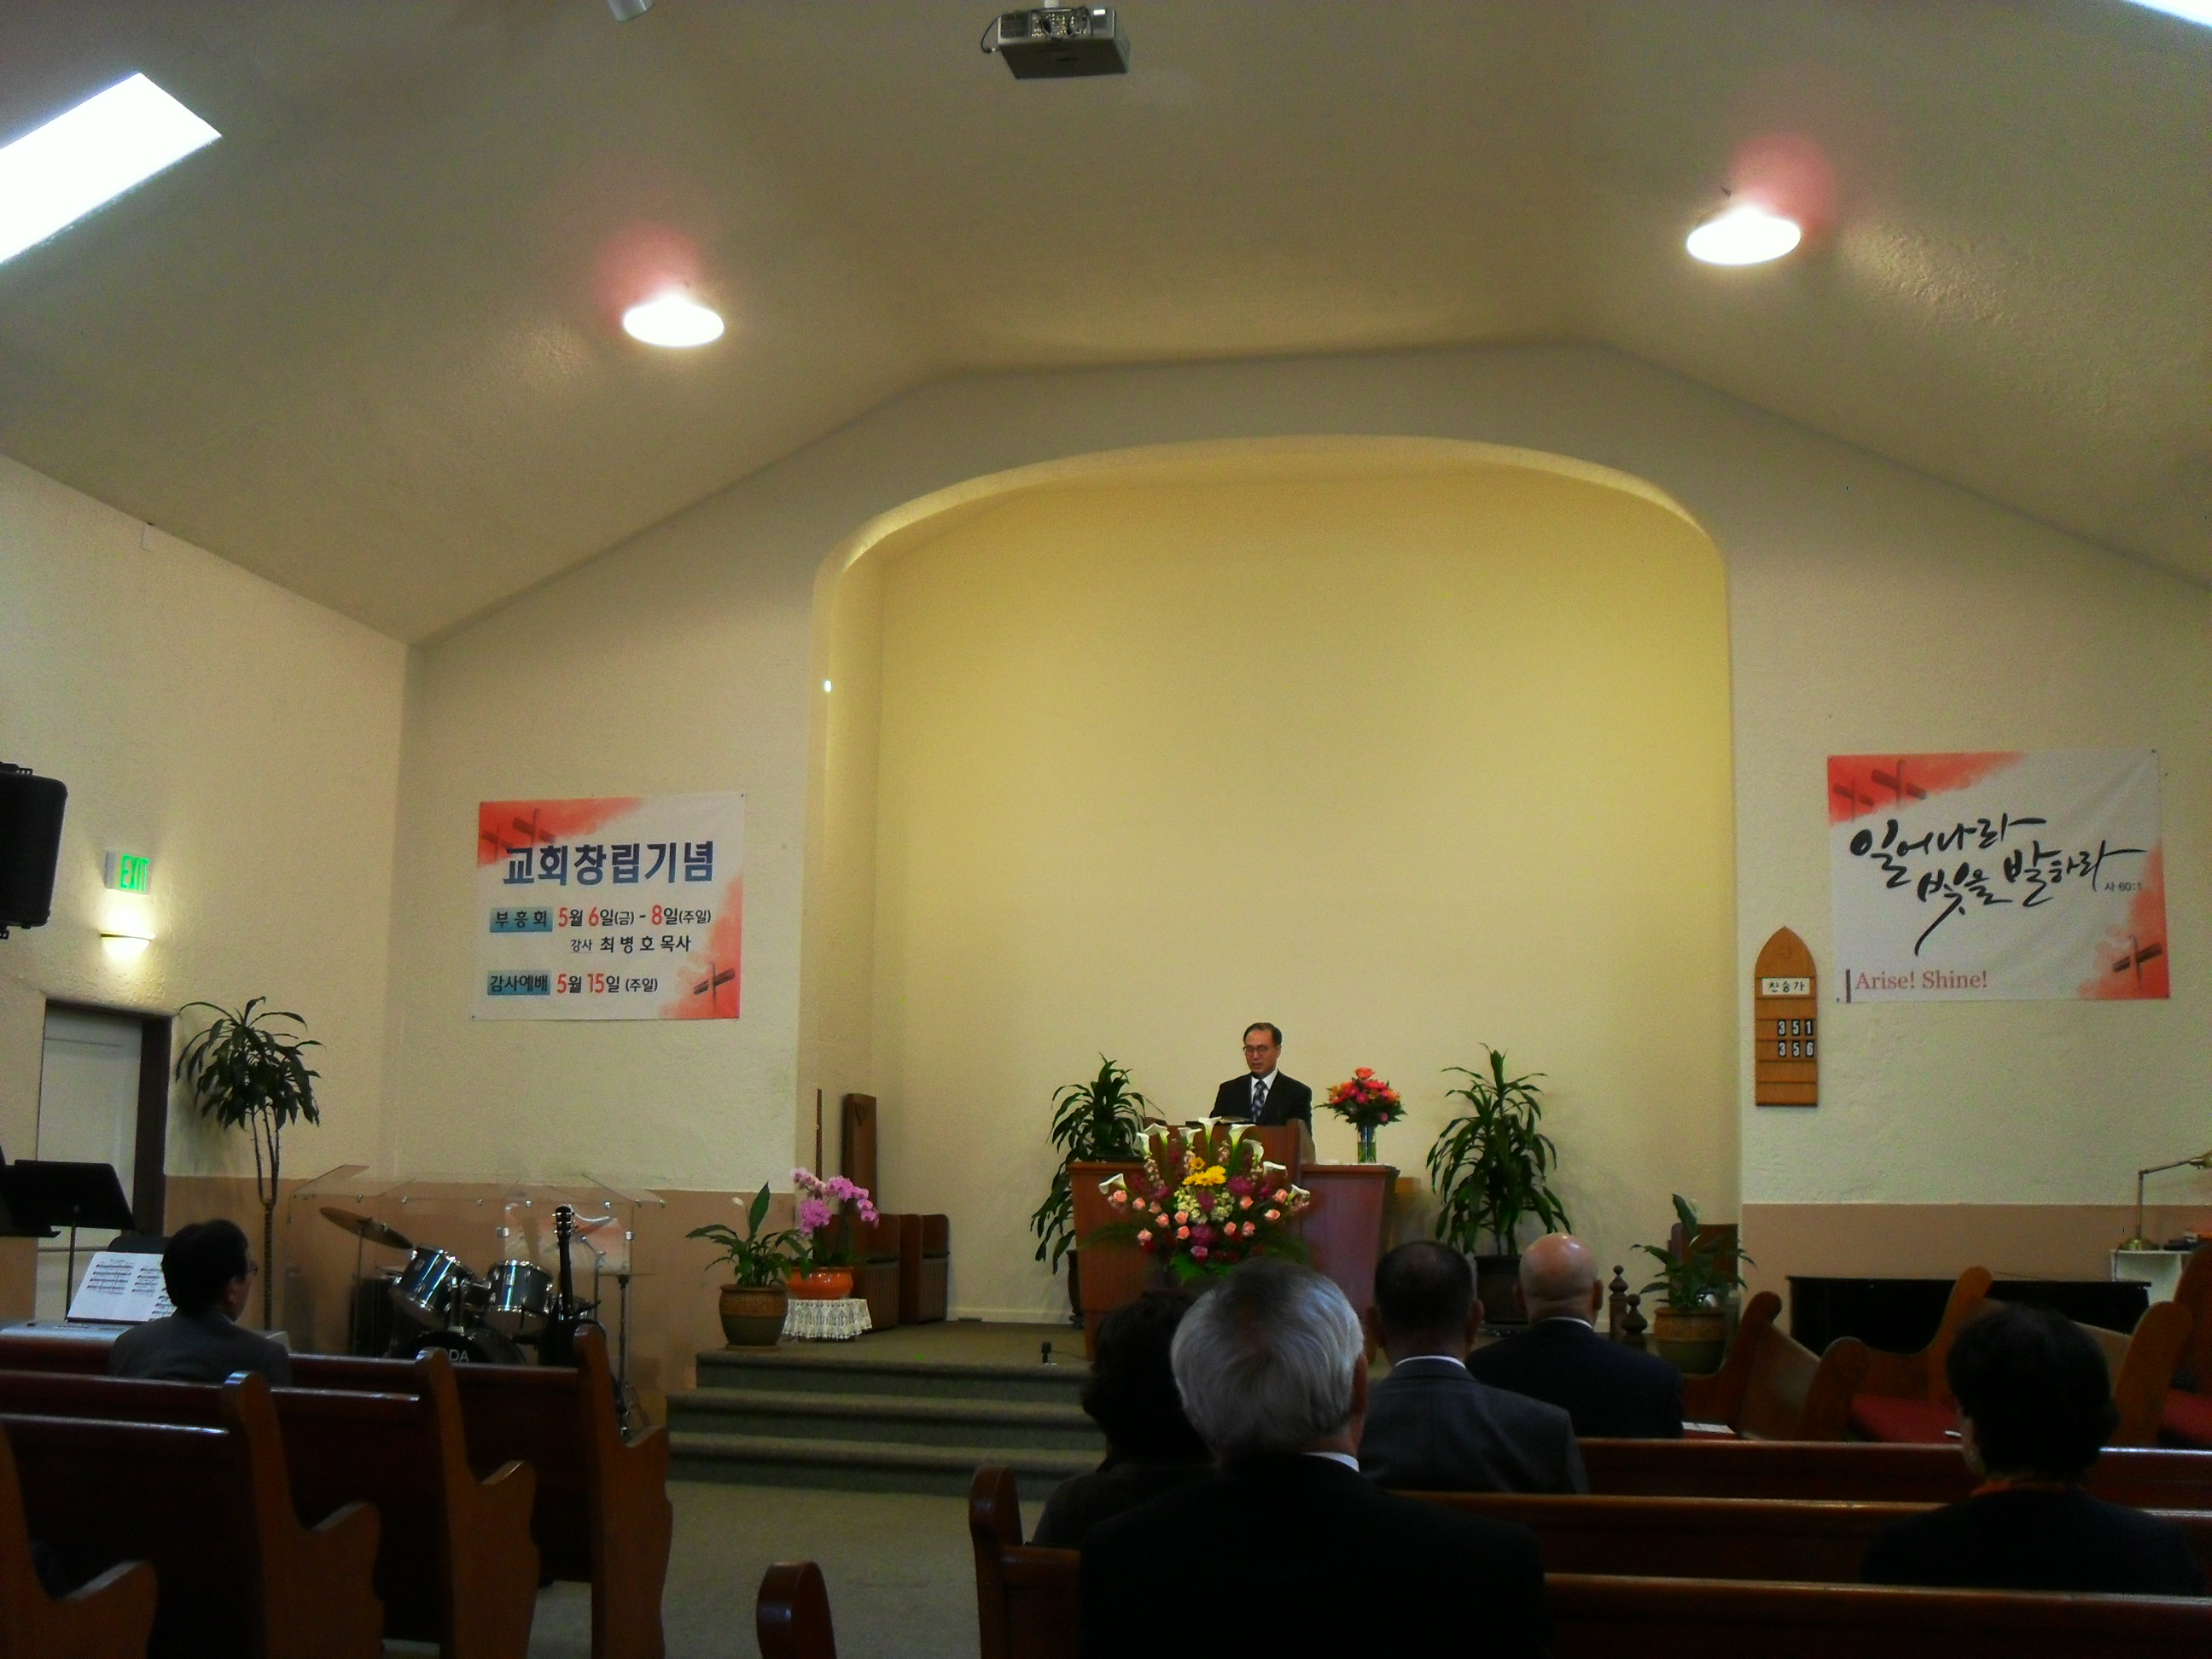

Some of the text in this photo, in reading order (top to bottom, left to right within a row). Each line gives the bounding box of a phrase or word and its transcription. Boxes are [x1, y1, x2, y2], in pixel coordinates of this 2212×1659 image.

[1849, 812, 2046, 889] 일어나라
[119, 853, 150, 893] EXIT
[503, 841, 714, 886] 교회창립기념
[1913, 840, 2148, 956] 빛을 발하라
[558, 906, 584, 928] 5월
[588, 906, 635, 927] 6일(금)
[651, 905, 712, 925] 8일(주일)
[570, 939, 593, 953] 강사
[660, 934, 691, 952] 목사
[490, 973, 658, 994] 감사예배 5월 15일 (주일)
[1855, 969, 1988, 990] Arise! Shine!
[1778, 1020, 1813, 1035] 351
[1778, 1042, 1814, 1057] 356
